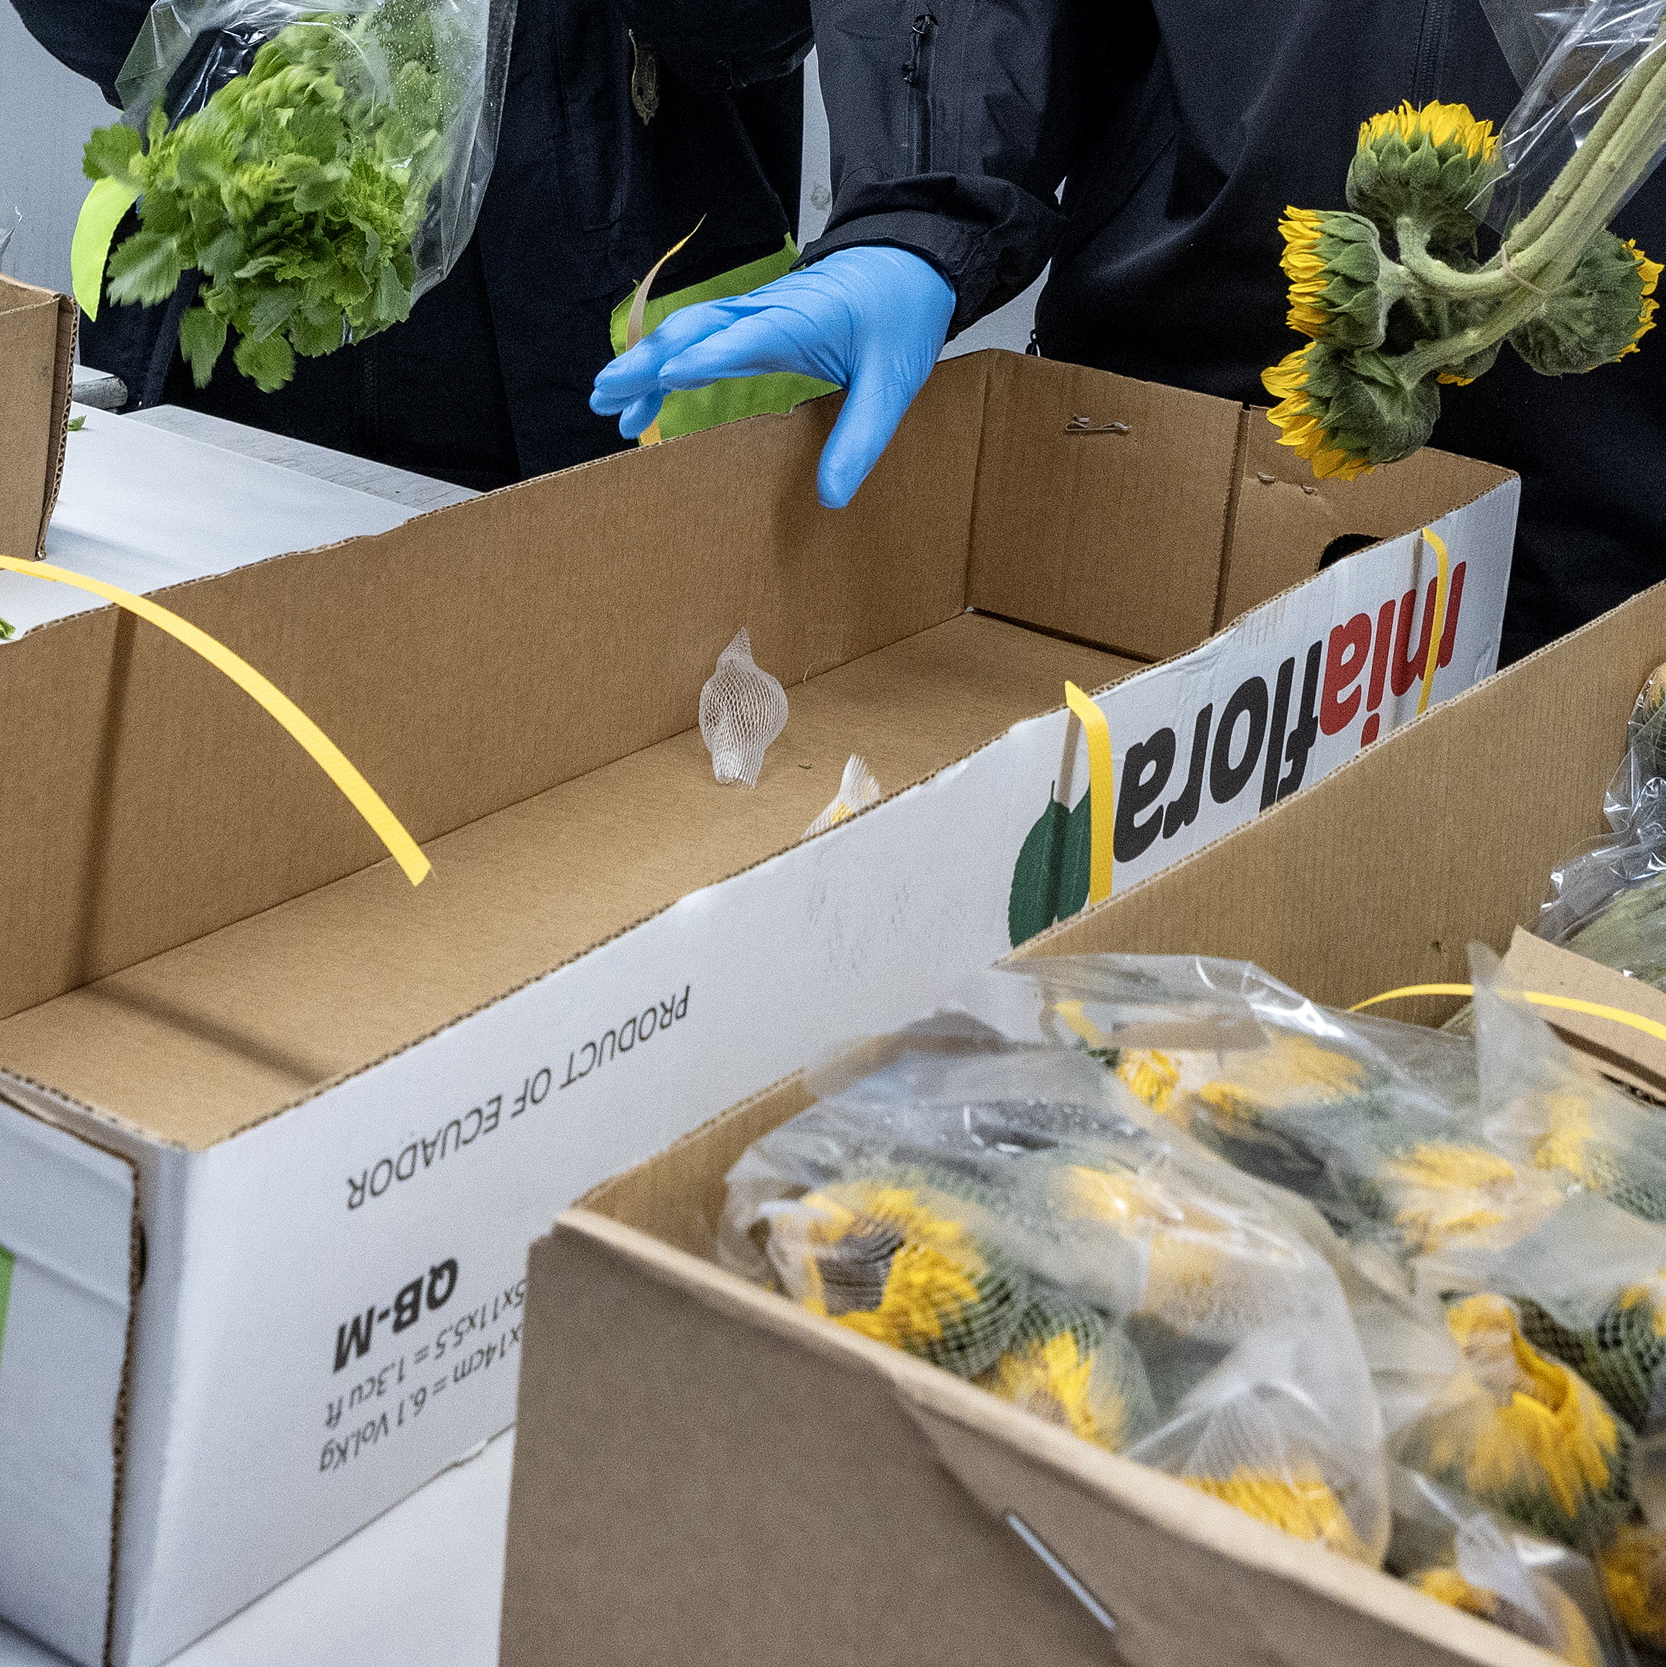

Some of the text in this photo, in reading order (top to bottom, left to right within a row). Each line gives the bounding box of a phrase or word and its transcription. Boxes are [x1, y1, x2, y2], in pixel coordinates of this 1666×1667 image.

[1113, 561, 1467, 864] miaflora
[346, 984, 691, 1211] PRODUCT OF ECUADOR
[333, 1256, 459, 1373] QB-M
[434, 1278, 527, 1361] 5x11x5.5
[453, 1322, 524, 1383] x14cm
